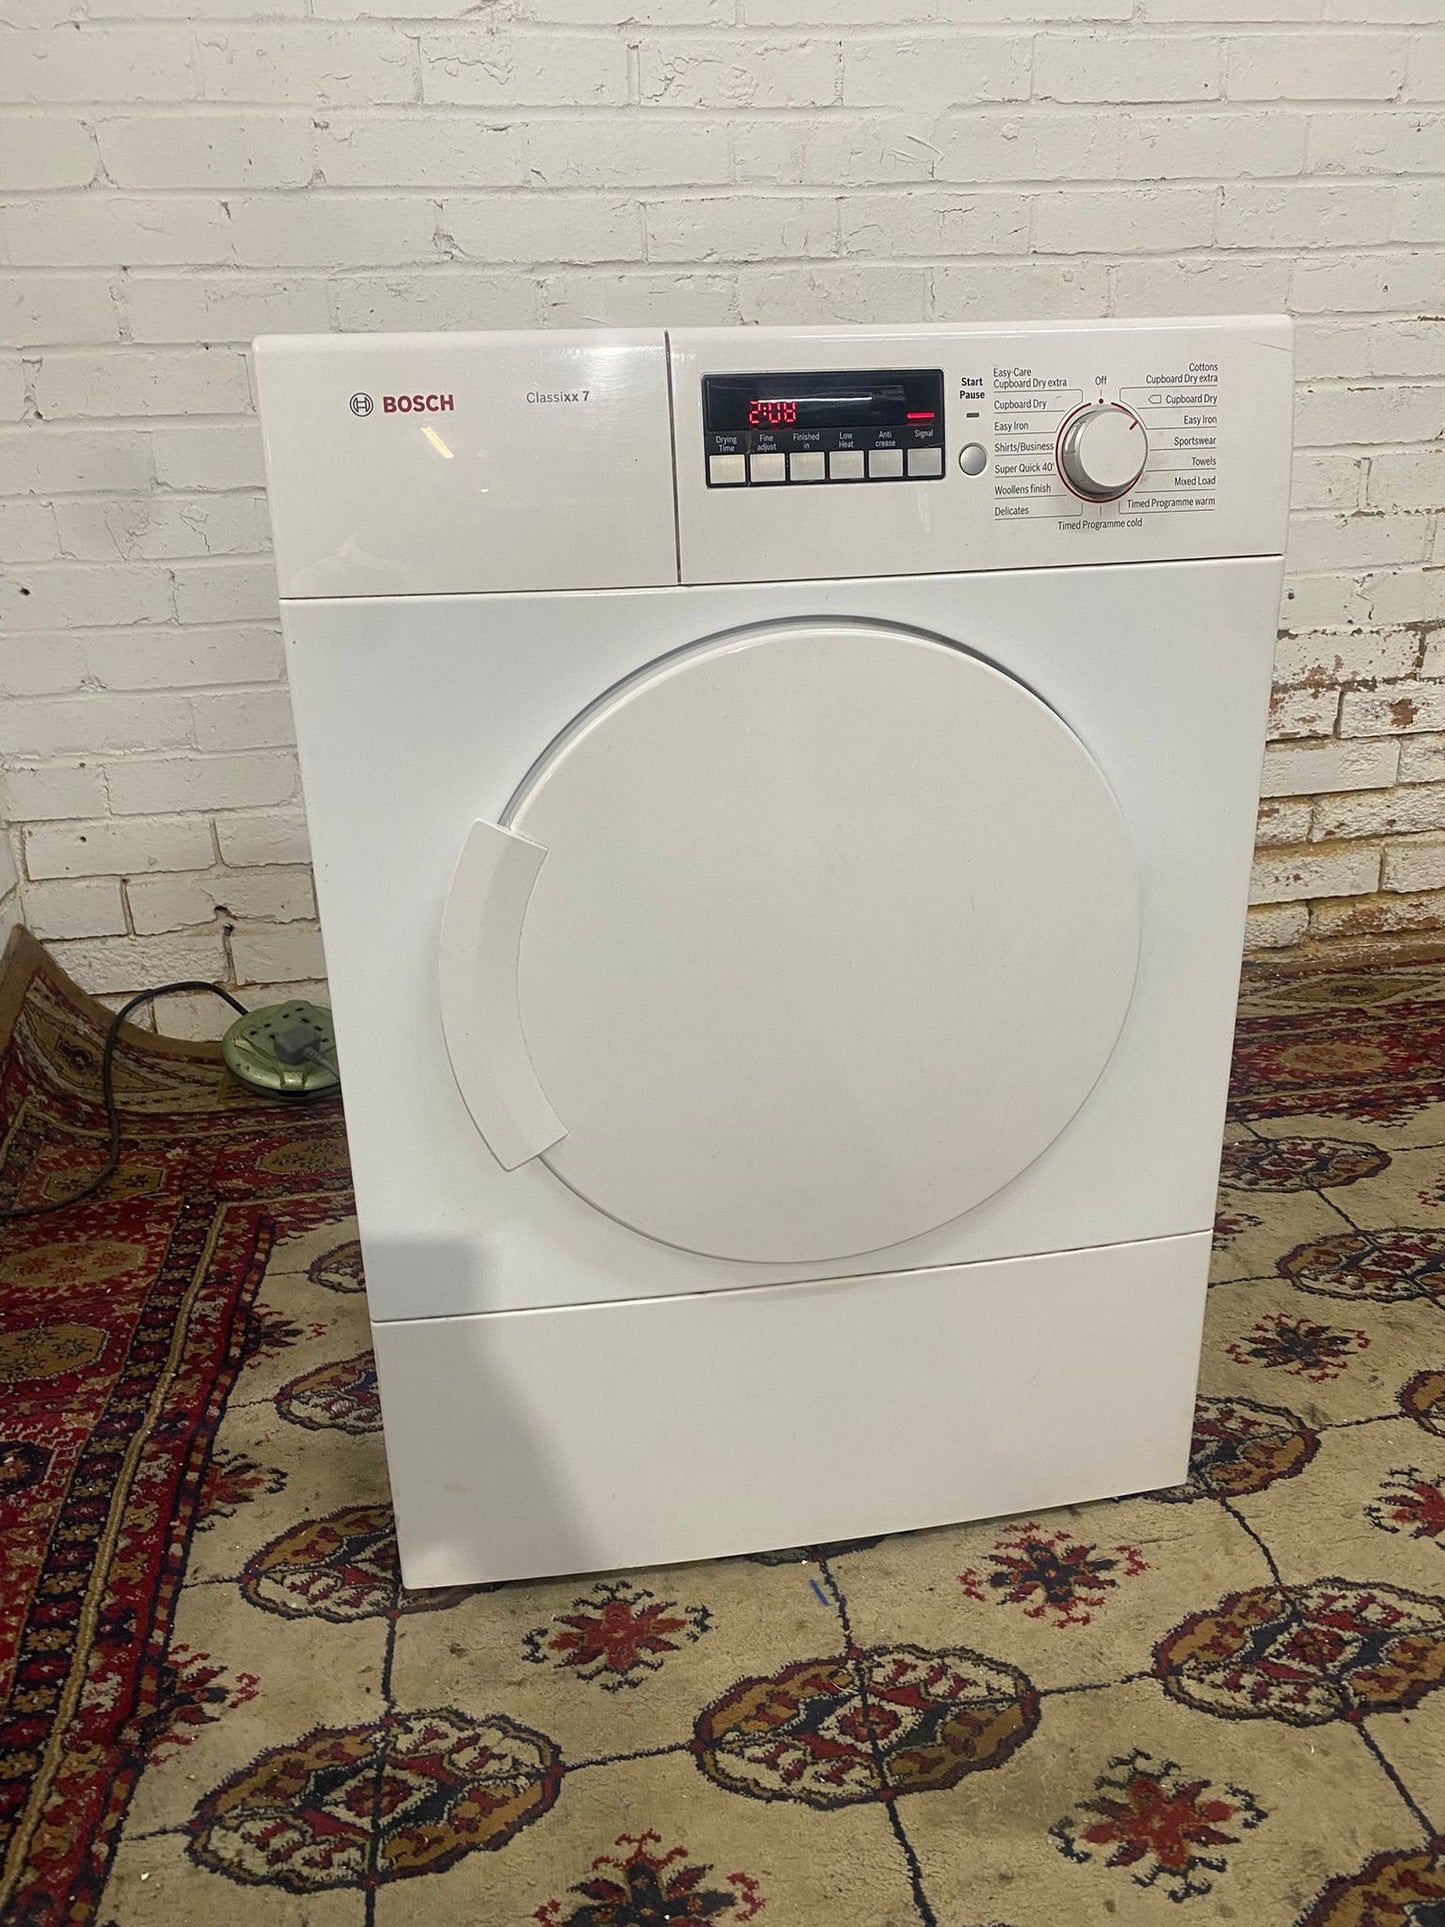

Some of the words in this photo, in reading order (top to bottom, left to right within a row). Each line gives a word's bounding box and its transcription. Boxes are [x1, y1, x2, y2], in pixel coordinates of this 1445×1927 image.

[1189, 363, 1218, 371] Cottons
[961, 378, 983, 386] Start
[994, 379, 1032, 388] Cupboard
[1033, 378, 1047, 388] Dry
[1095, 376, 1107, 385] Off
[1146, 374, 1183, 384] Cupboard
[1184, 374, 1198, 384] Dry
[1199, 374, 1218, 382] extra
[526, 391, 579, 404] Classixx
[582, 391, 590, 402] 7
[960, 391, 985, 399] Pause
[1166, 395, 1203, 404] Cupboard
[1204, 394, 1217, 404] Dry
[383, 394, 455, 413] BOSCH
[994, 400, 1032, 410] Cupboard
[1033, 400, 1047, 408] Dry
[1184, 415, 1201, 425] Easy
[1202, 415, 1217, 423] Iron
[994, 422, 1012, 431] Easy
[1014, 422, 1029, 430] Iron
[793, 433, 820, 441] Finished
[914, 429, 933, 438] Signal
[716, 436, 737, 445] Drying
[1174, 437, 1216, 447] Sportswear
[757, 444, 776, 452] adjust
[995, 442, 1054, 452] Shirts/Business
[1192, 457, 1216, 466] Towels
[995, 464, 1017, 474] Super
[1019, 462, 1040, 472] Quick
[1174, 477, 1196, 486] Mixed
[1198, 476, 1216, 485] Load
[995, 486, 1028, 495] Woollens
[1031, 484, 1051, 493] finish
[1127, 499, 1149, 508] Timed
[1151, 498, 1193, 509] Programme
[995, 506, 1029, 516] Delicates
[1058, 521, 1081, 530] Timed
[1082, 519, 1125, 530] Programme
[1127, 518, 1142, 527] cold
